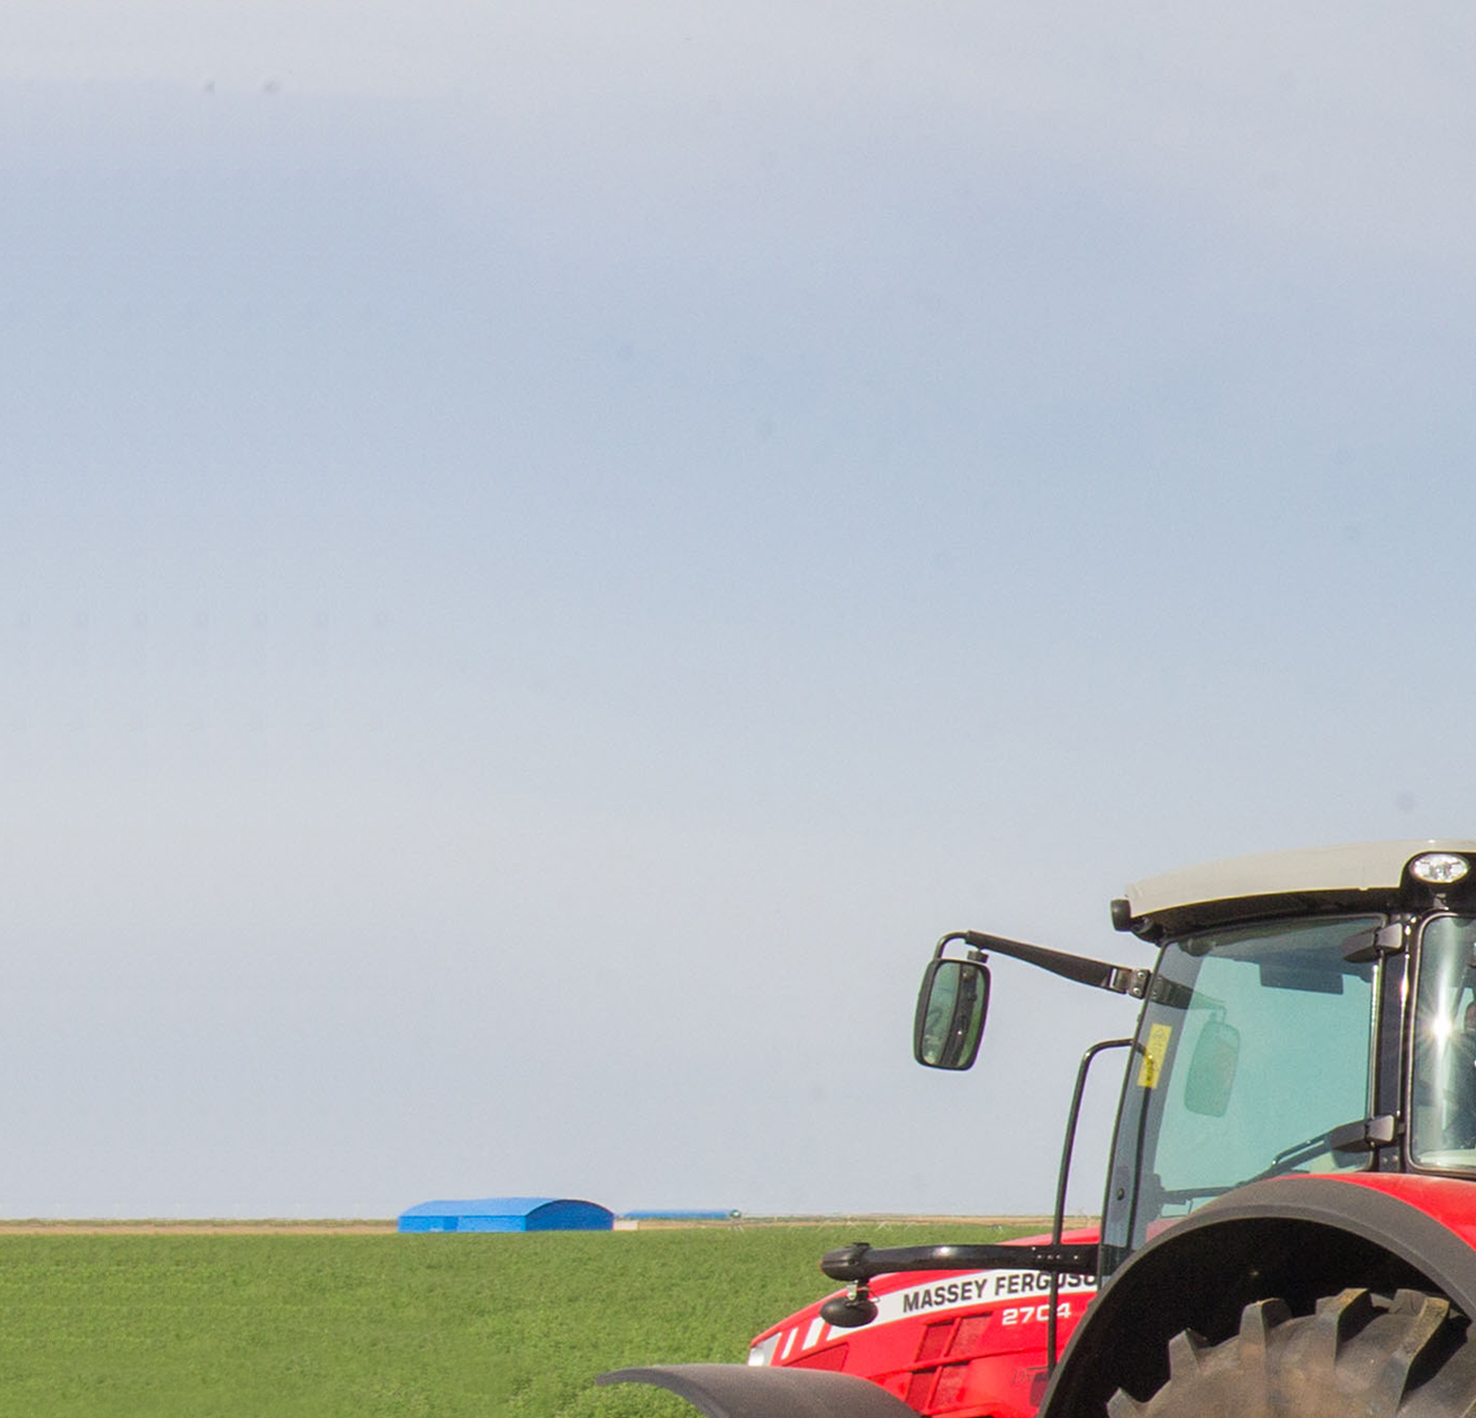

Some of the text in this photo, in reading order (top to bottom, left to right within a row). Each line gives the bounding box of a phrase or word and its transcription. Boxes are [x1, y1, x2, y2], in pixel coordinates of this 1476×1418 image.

[902, 1271, 1099, 1313] MASSEY FERGUSO
[1002, 1302, 1072, 1325] 2704
